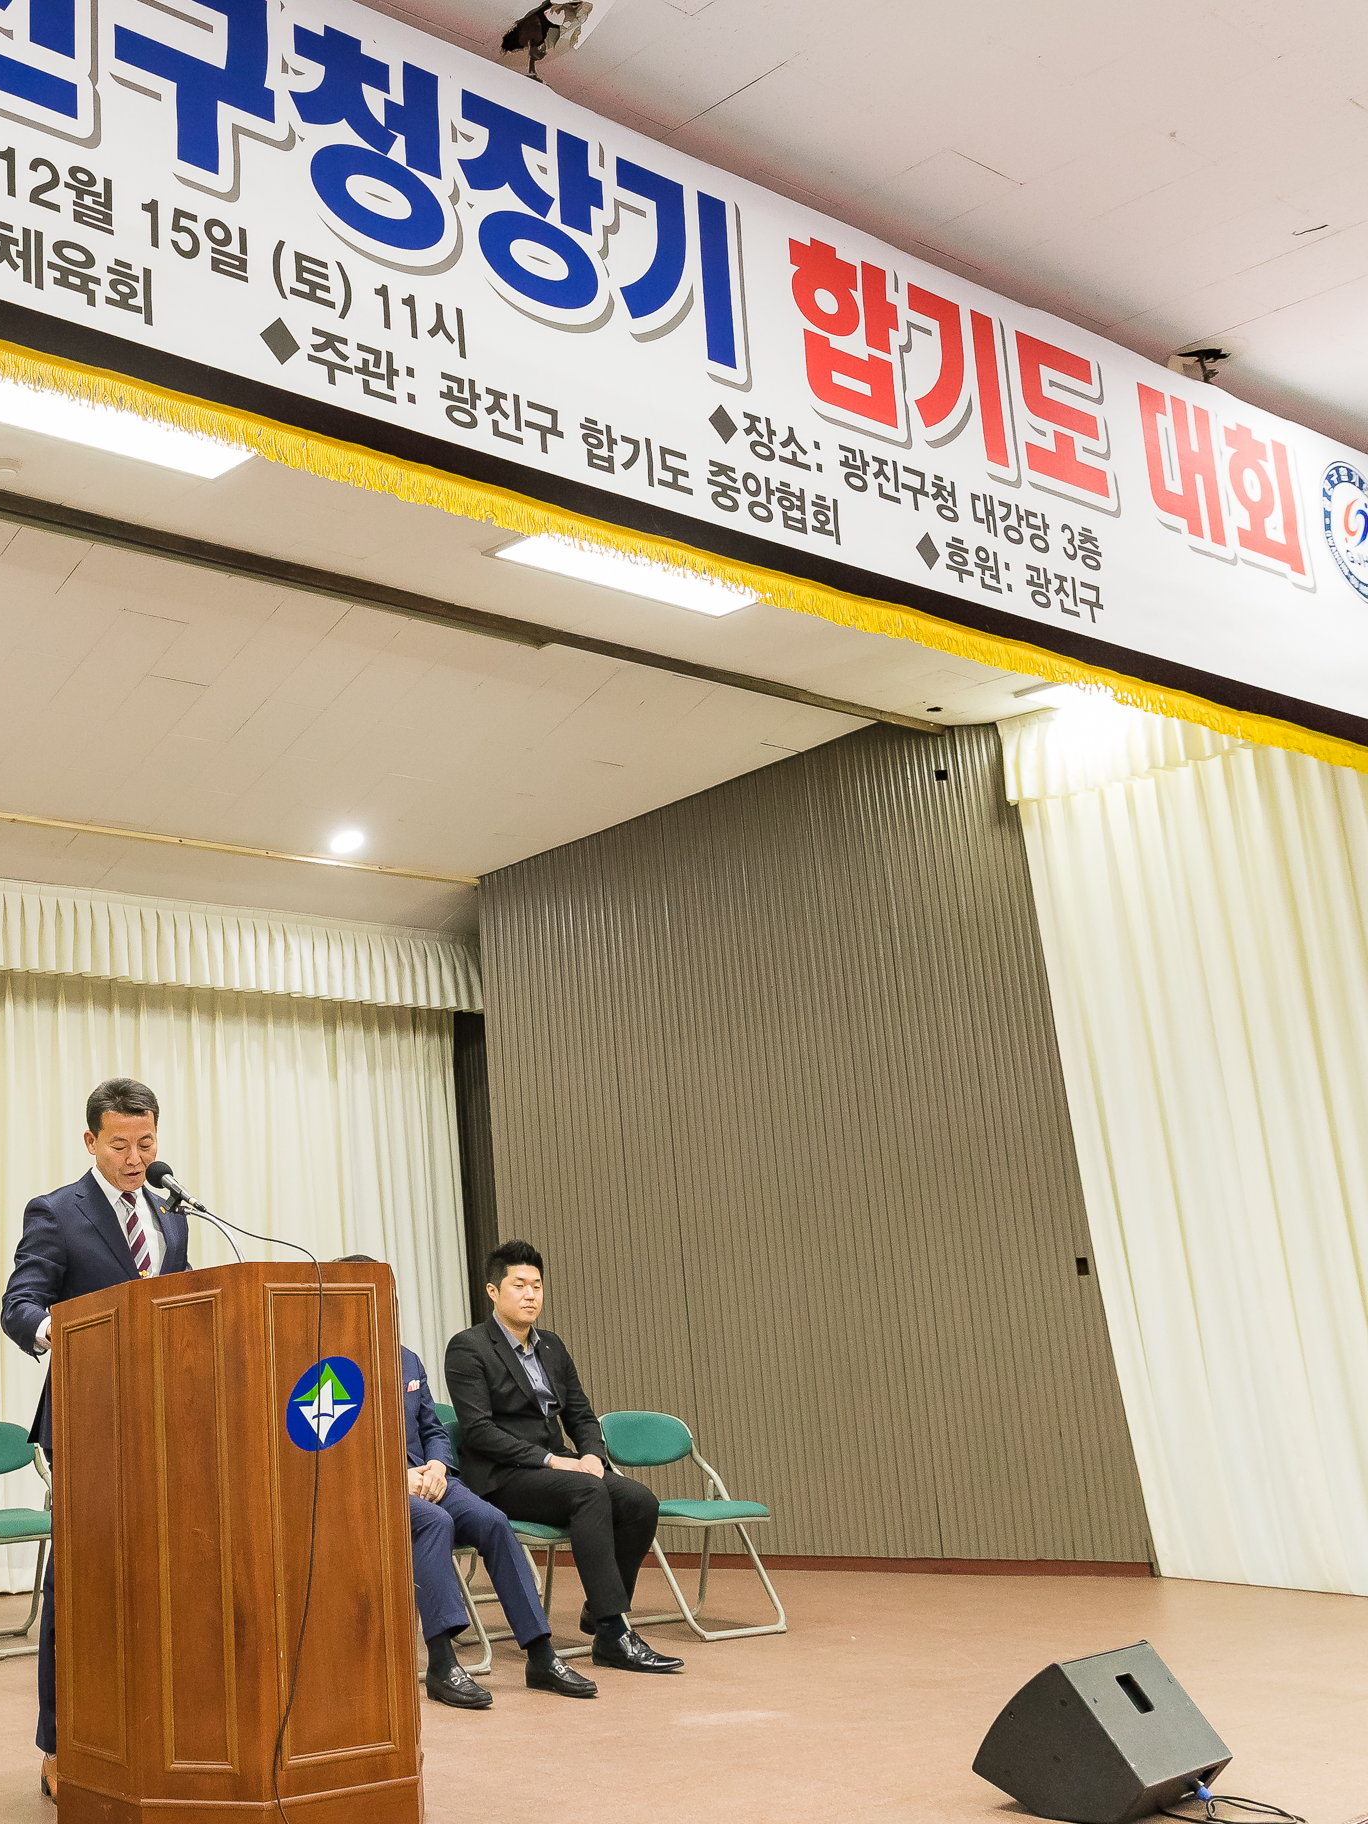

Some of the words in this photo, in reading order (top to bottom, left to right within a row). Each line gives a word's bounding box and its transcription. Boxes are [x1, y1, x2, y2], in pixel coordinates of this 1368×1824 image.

[141, 198, 249, 284] 15일
[272, 239, 353, 320] (토)
[373, 283, 468, 360] 11시
[307, 326, 418, 406] 주관:
[439, 371, 566, 455] 광진구
[579, 416, 695, 496] 합기도
[706, 459, 842, 546] 중앙협회
[788, 236, 1111, 499] 합기도
[1136, 381, 1306, 576] 대회
[742, 411, 825, 473] 장소:
[838, 443, 960, 523] 광진구청
[970, 491, 1052, 555] 대강당
[1060, 523, 1105, 572] 3층
[944, 536, 1014, 596] 후원:
[1025, 563, 1105, 625] 광진구
